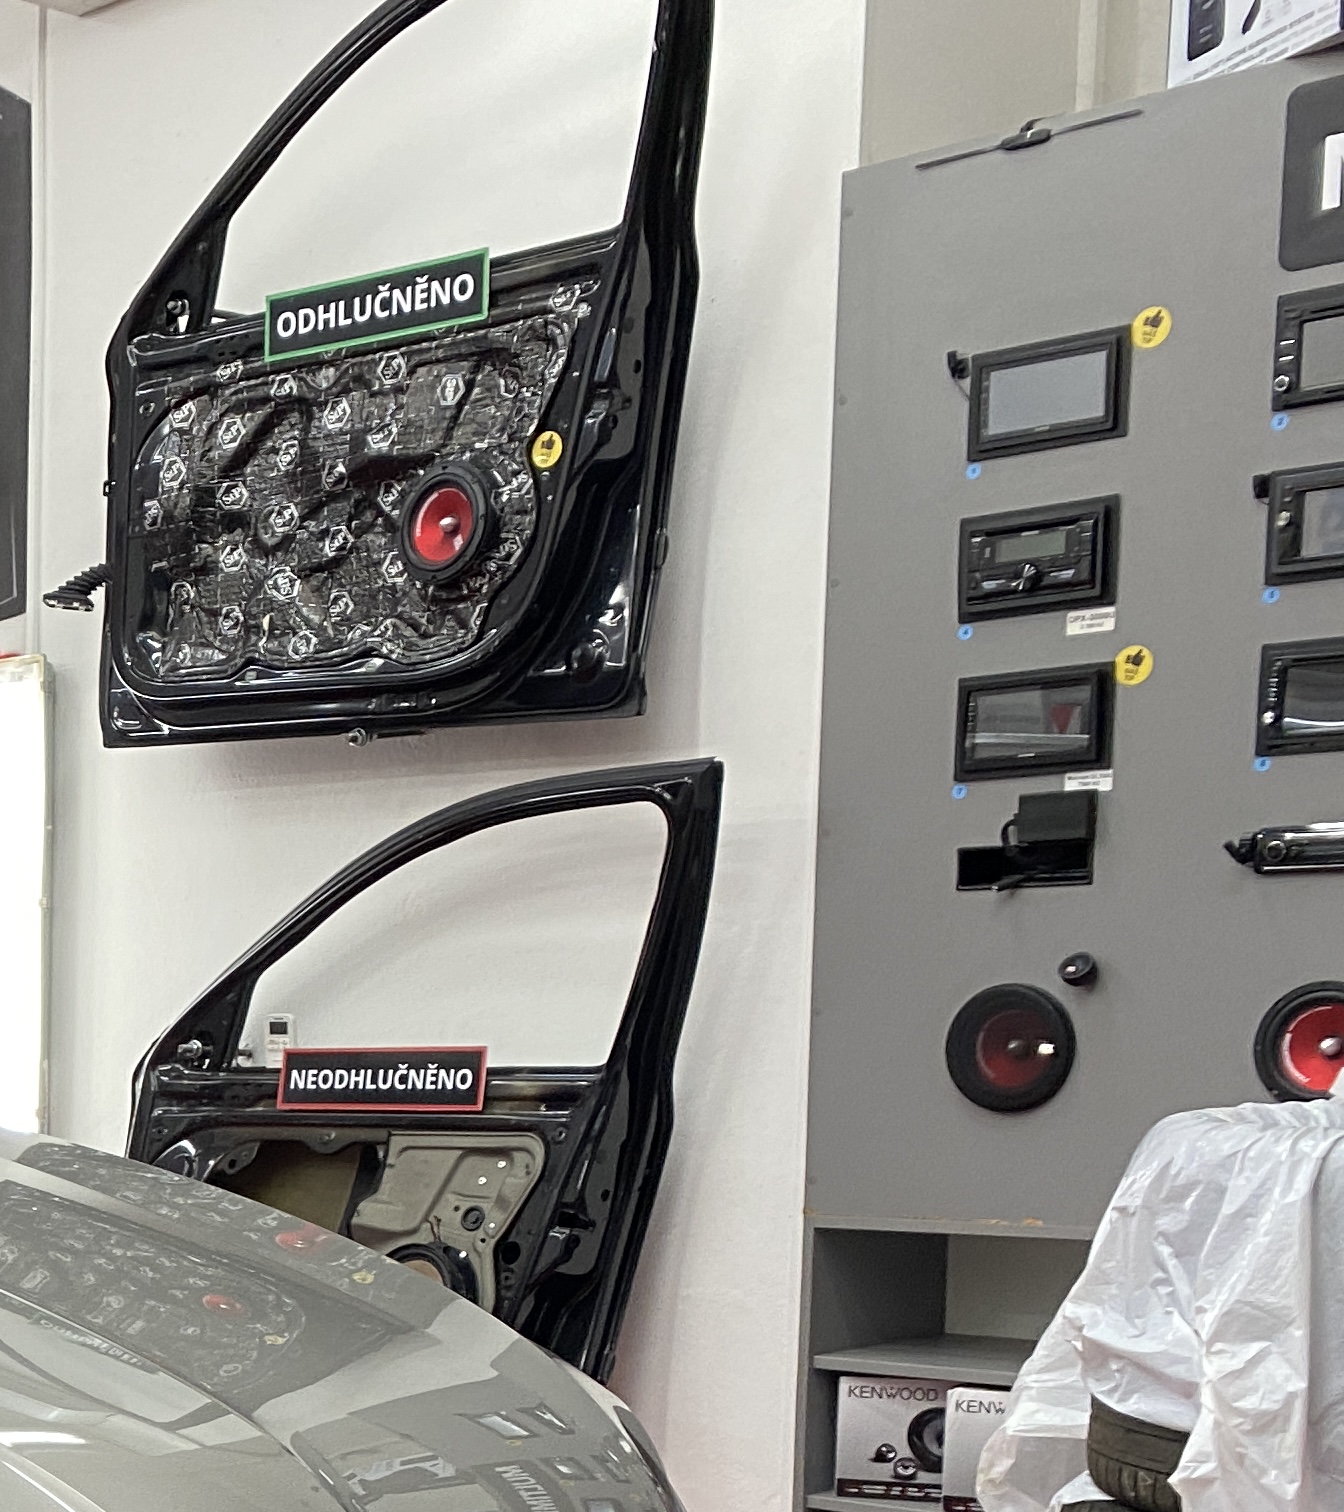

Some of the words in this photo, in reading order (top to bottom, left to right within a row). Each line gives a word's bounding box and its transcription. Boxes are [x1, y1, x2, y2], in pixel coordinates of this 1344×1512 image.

[276, 272, 476, 339] ODHLUČNĚNO
[289, 1063, 474, 1091] NEODHLUČNĚNO
[847, 1385, 939, 1402] KENWOOD
